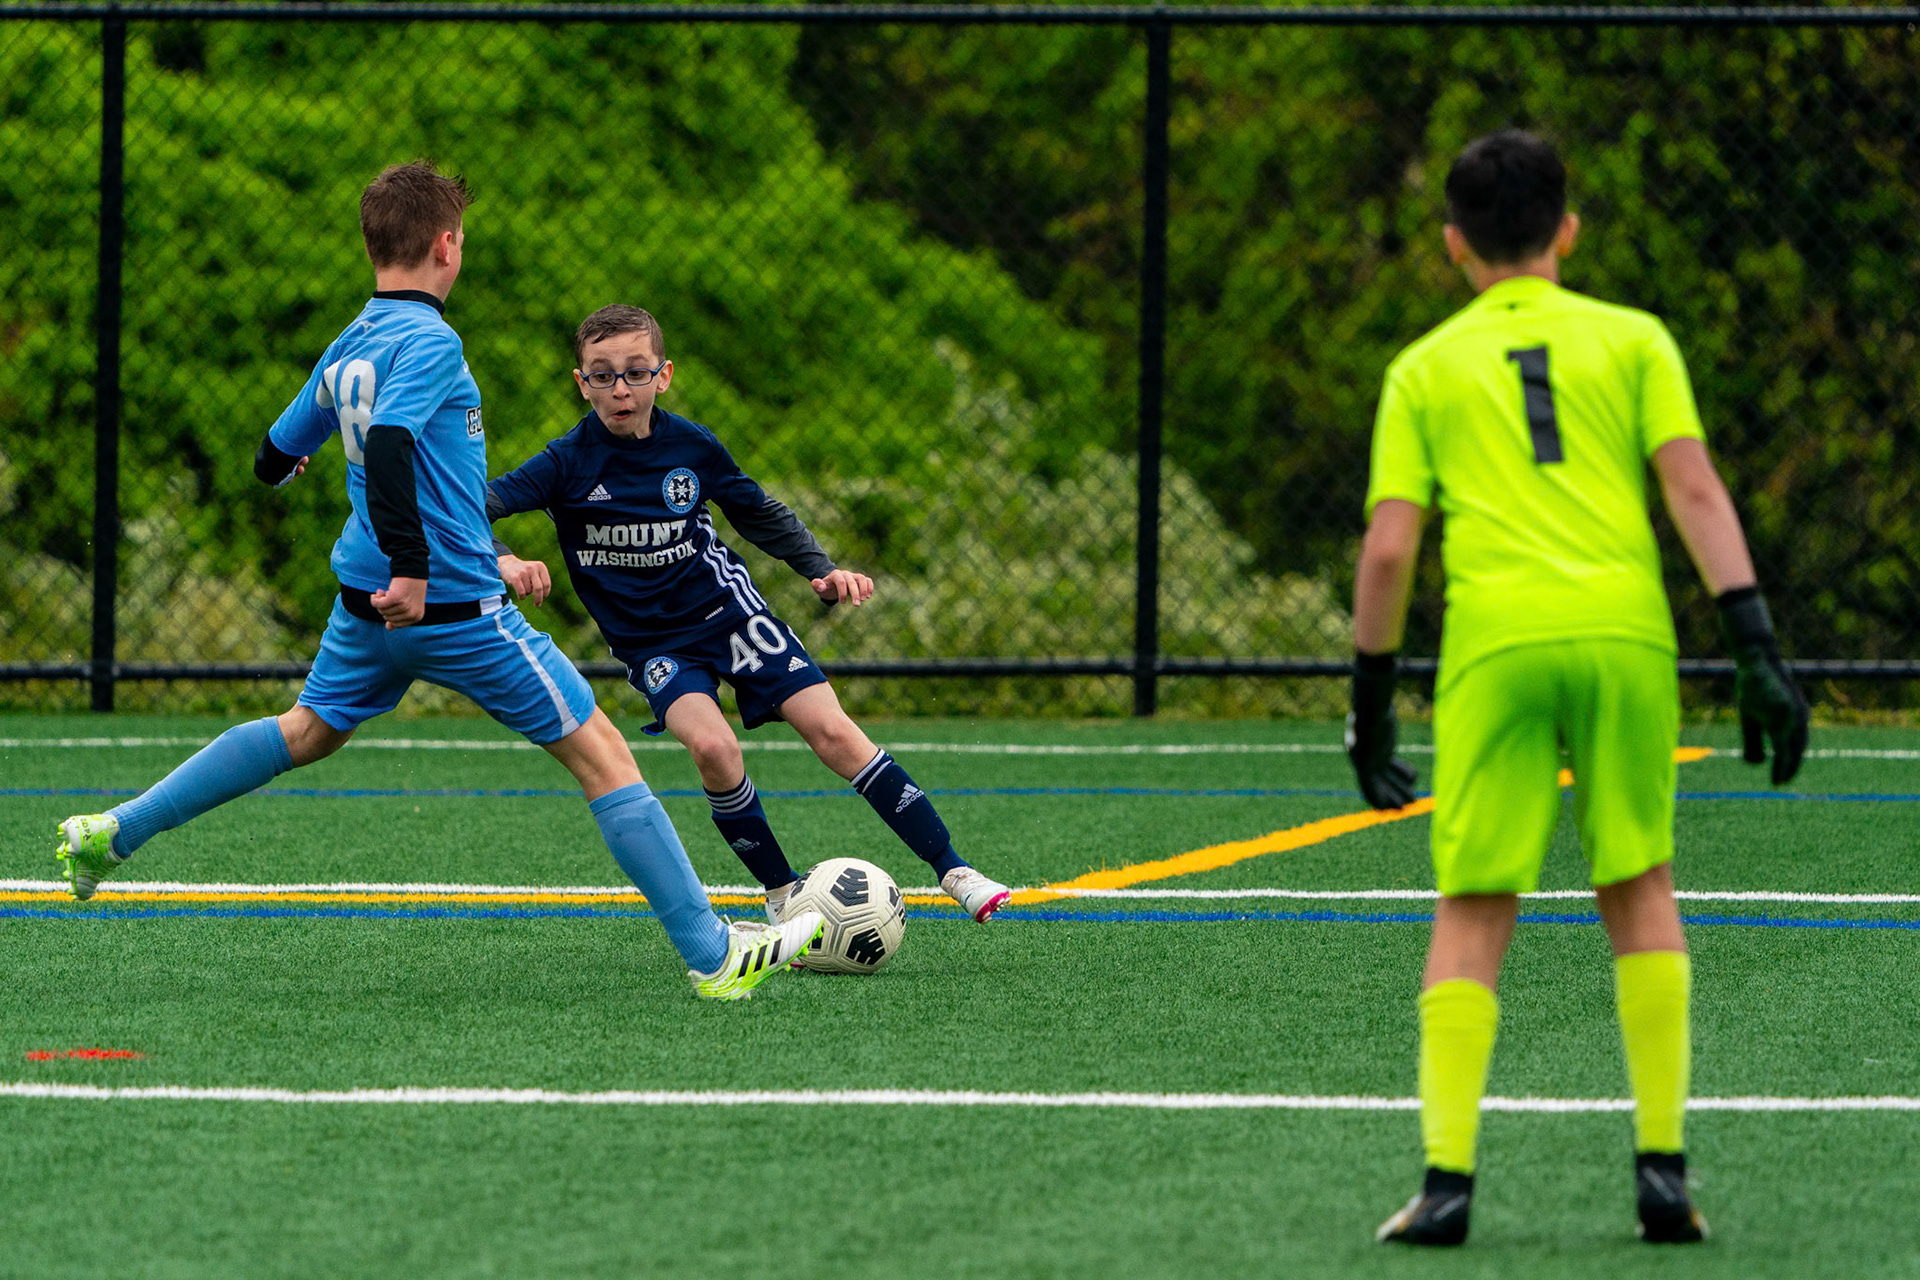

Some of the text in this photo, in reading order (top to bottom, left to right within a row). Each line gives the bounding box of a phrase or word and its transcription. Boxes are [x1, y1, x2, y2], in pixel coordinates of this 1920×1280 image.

[1507, 345, 1563, 463] 1
[585, 520, 687, 547] MOUNT
[729, 614, 788, 674] 40
[895, 789, 925, 813] adidas
